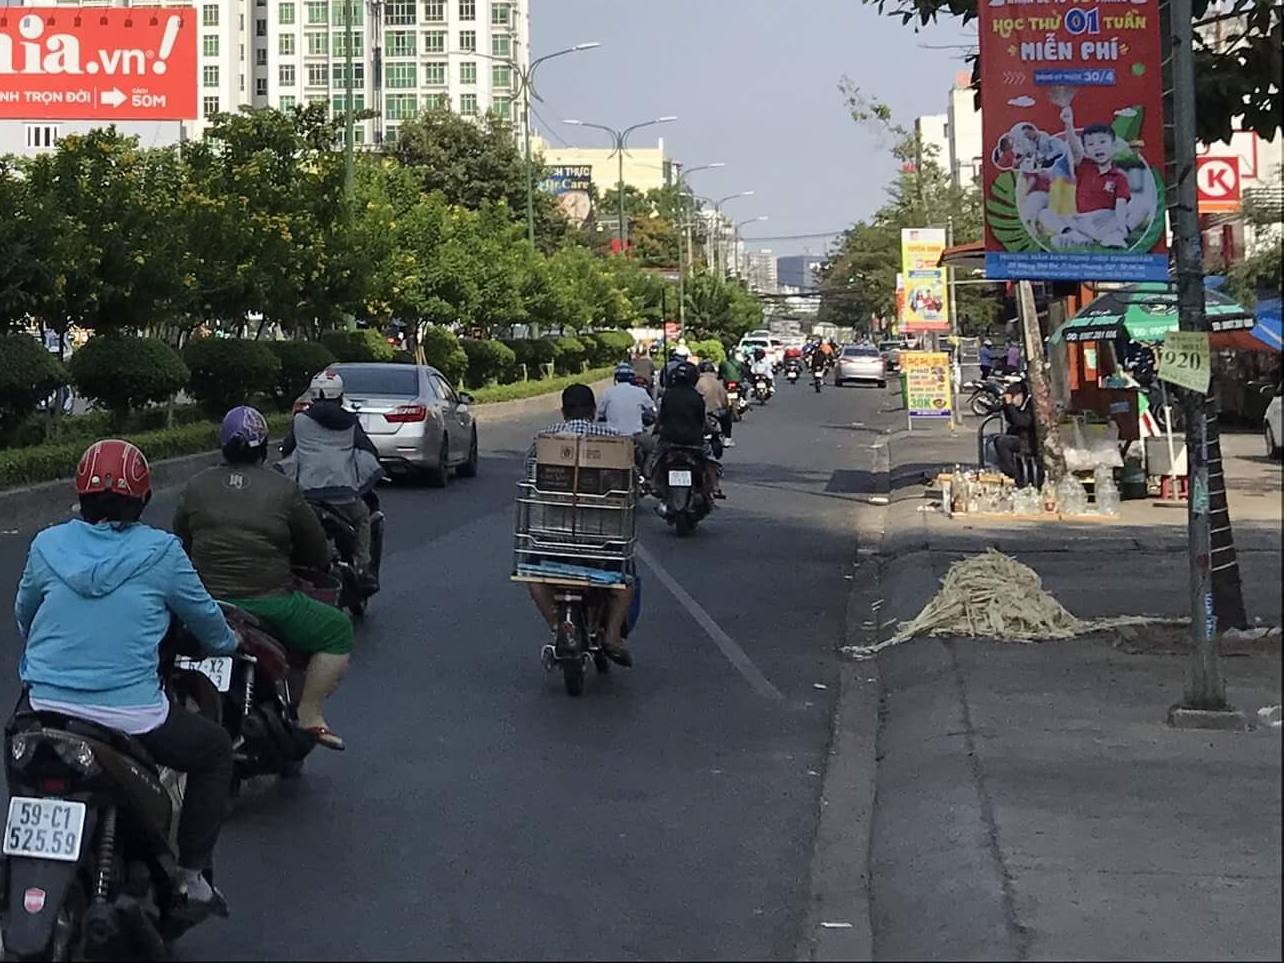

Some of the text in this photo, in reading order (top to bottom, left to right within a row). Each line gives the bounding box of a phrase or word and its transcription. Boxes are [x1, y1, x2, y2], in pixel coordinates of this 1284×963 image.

[992, 17, 1025, 38] HỌC
[1064, 6, 1101, 35] 01
[1103, 8, 1147, 30] TUẦN
[1020, 32, 1119, 61] MIỄN PHÍ
[1084, 70, 1114, 83] 30/4
[23, 90, 63, 106] TRỌN
[66, 88, 91, 103] ĐỜI
[131, 94, 166, 108] 50M
[1164, 350, 1201, 371] 920
[19, 802, 72, 830] 59-C1
[8, 826, 77, 856] 525.59
